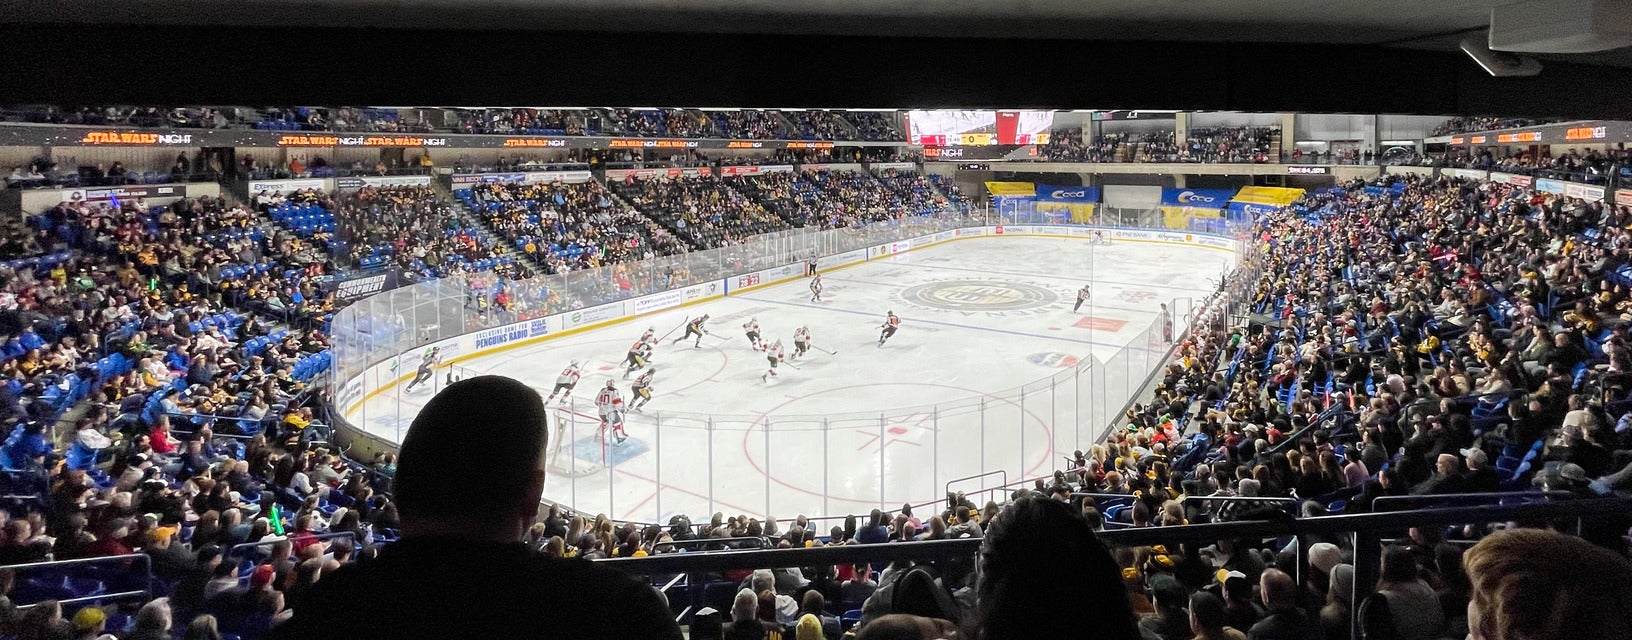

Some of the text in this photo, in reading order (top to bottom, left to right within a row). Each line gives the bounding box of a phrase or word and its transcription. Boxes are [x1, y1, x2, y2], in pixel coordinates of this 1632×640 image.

[83, 132, 192, 144] STAR WARS NIGHT
[278, 136, 364, 146] STAR WARS NIGHT
[364, 137, 446, 146] STAR WARS NIGHT
[503, 139, 526, 147] STAR
[526, 139, 548, 147] WARS
[941, 148, 963, 157] NIGHT
[335, 281, 384, 298] EQUIPMENT
[475, 333, 508, 349] PENGUINS
[508, 329, 528, 341] RADIO
